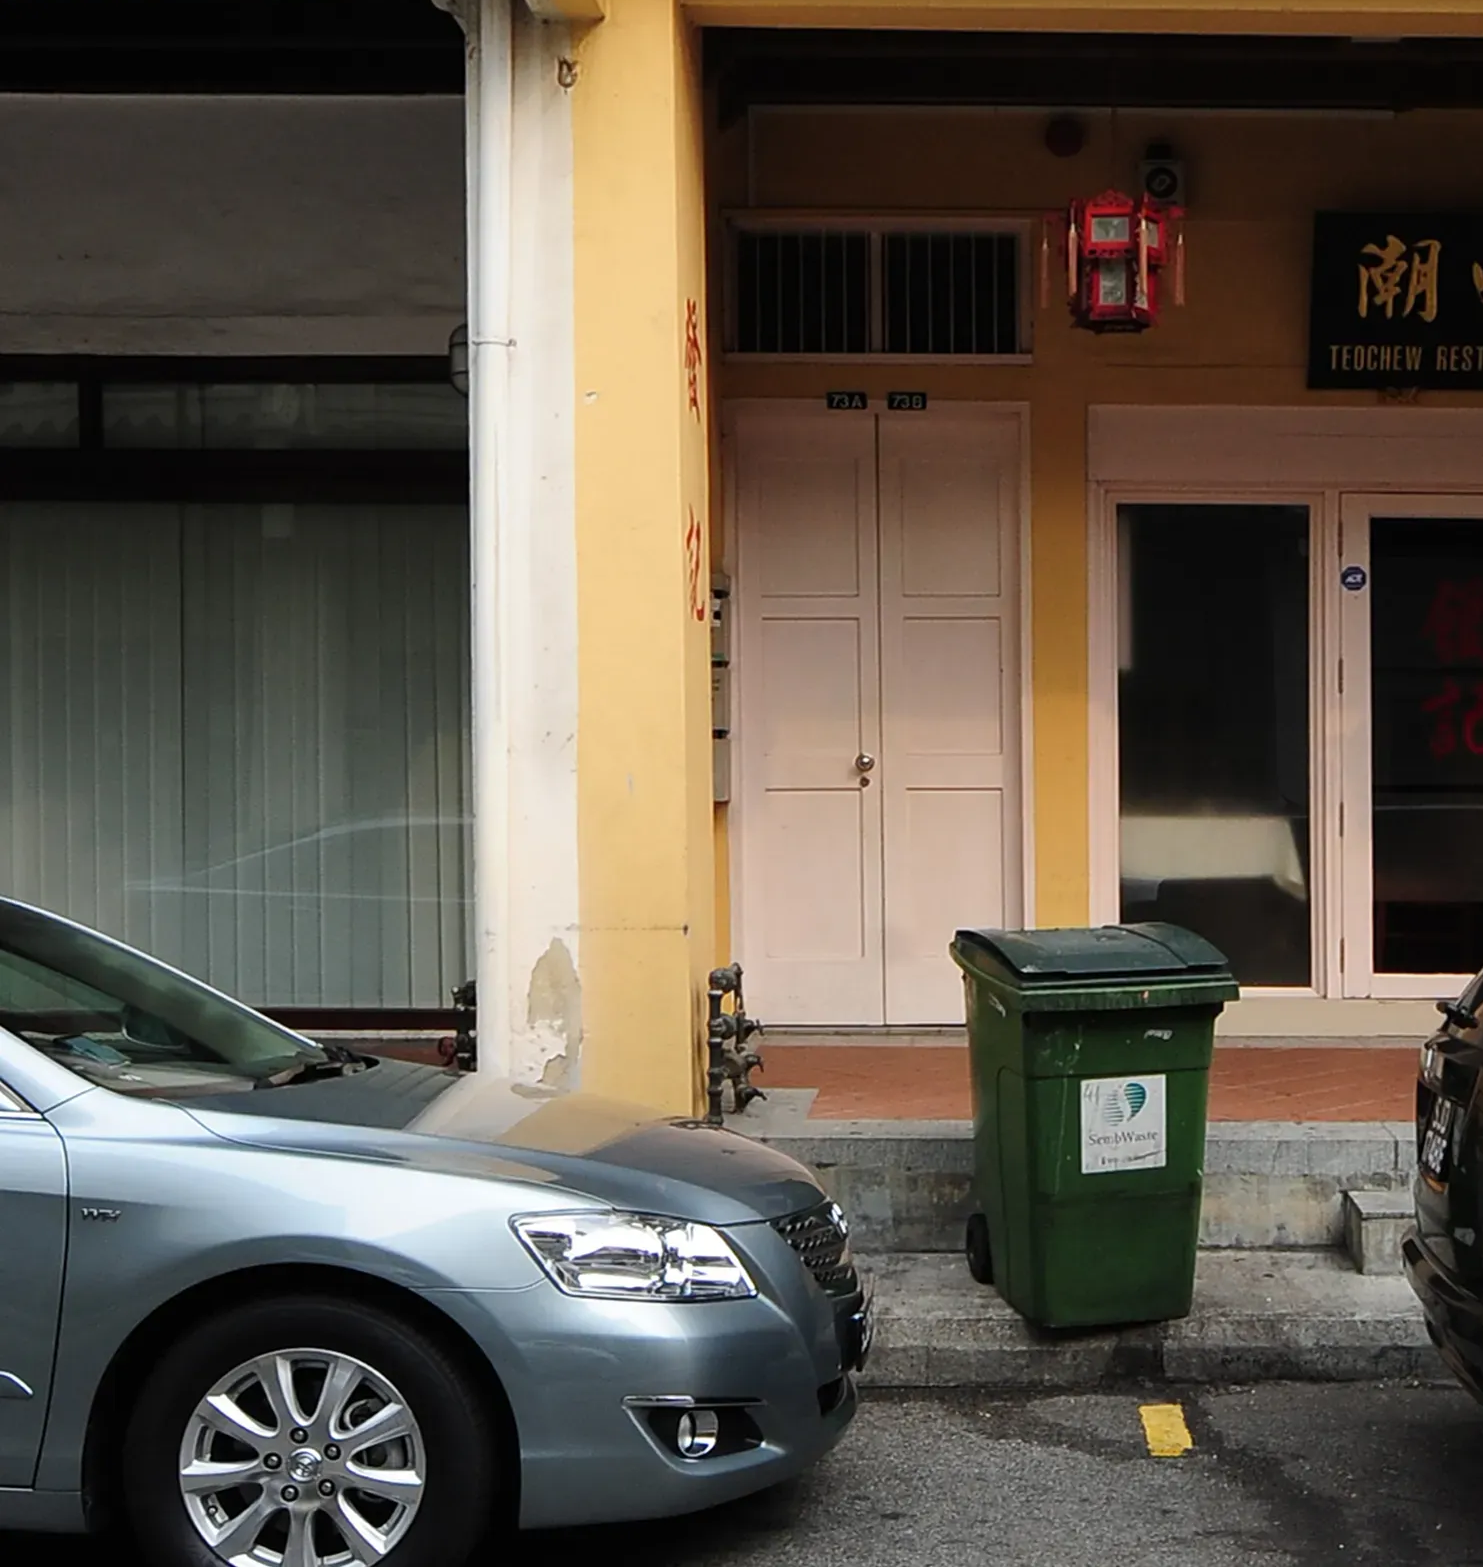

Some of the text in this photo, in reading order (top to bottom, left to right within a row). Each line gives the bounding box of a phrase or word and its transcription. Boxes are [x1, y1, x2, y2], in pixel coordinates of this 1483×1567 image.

[1329, 343, 1424, 372] TEOCHEW
[831, 394, 863, 408] 73A
[1088, 1130, 1159, 1146] SembWaste
